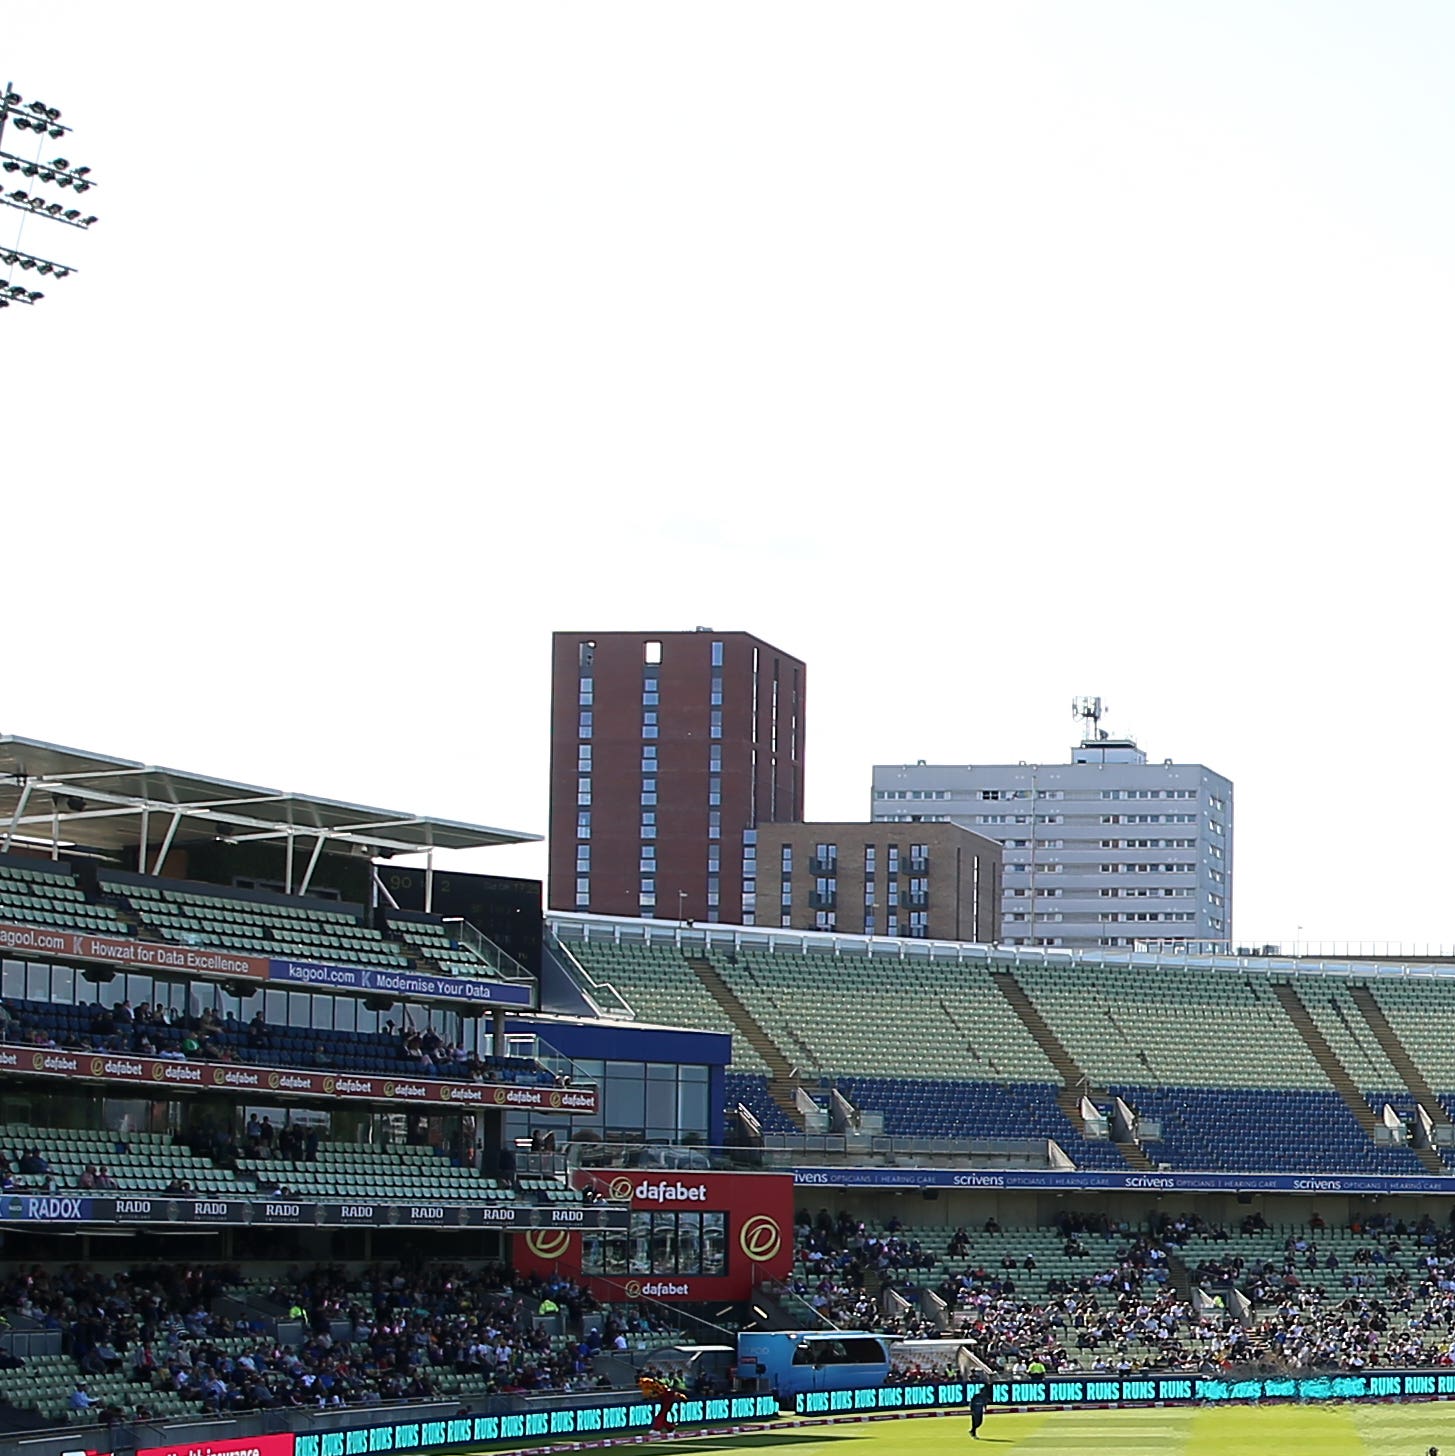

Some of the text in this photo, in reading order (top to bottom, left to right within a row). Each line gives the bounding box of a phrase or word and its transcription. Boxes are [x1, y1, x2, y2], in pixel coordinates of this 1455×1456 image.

[91, 940, 135, 960] Howzat
[137, 946, 155, 962] for
[157, 949, 185, 967] Data
[187, 953, 249, 973] Excellence
[288, 963, 491, 999] kagool.com Modernise Your Data
[44, 1056, 596, 1108] dafabet dafabet dafabet dafabet dafabet dafabet dafabet
[635, 1181, 707, 1204] dafabet
[953, 1174, 1004, 1187] scrivens
[1124, 1175, 1174, 1188] scrivens
[1293, 1178, 1342, 1191] scrivens
[28, 1199, 584, 1223] RADOX RADO RADO RADO RADO RADO RADO RADO
[642, 1282, 689, 1299] dafabet
[1087, 1382, 1119, 1400] RUNS
[1160, 1381, 1192, 1398] RUNS
